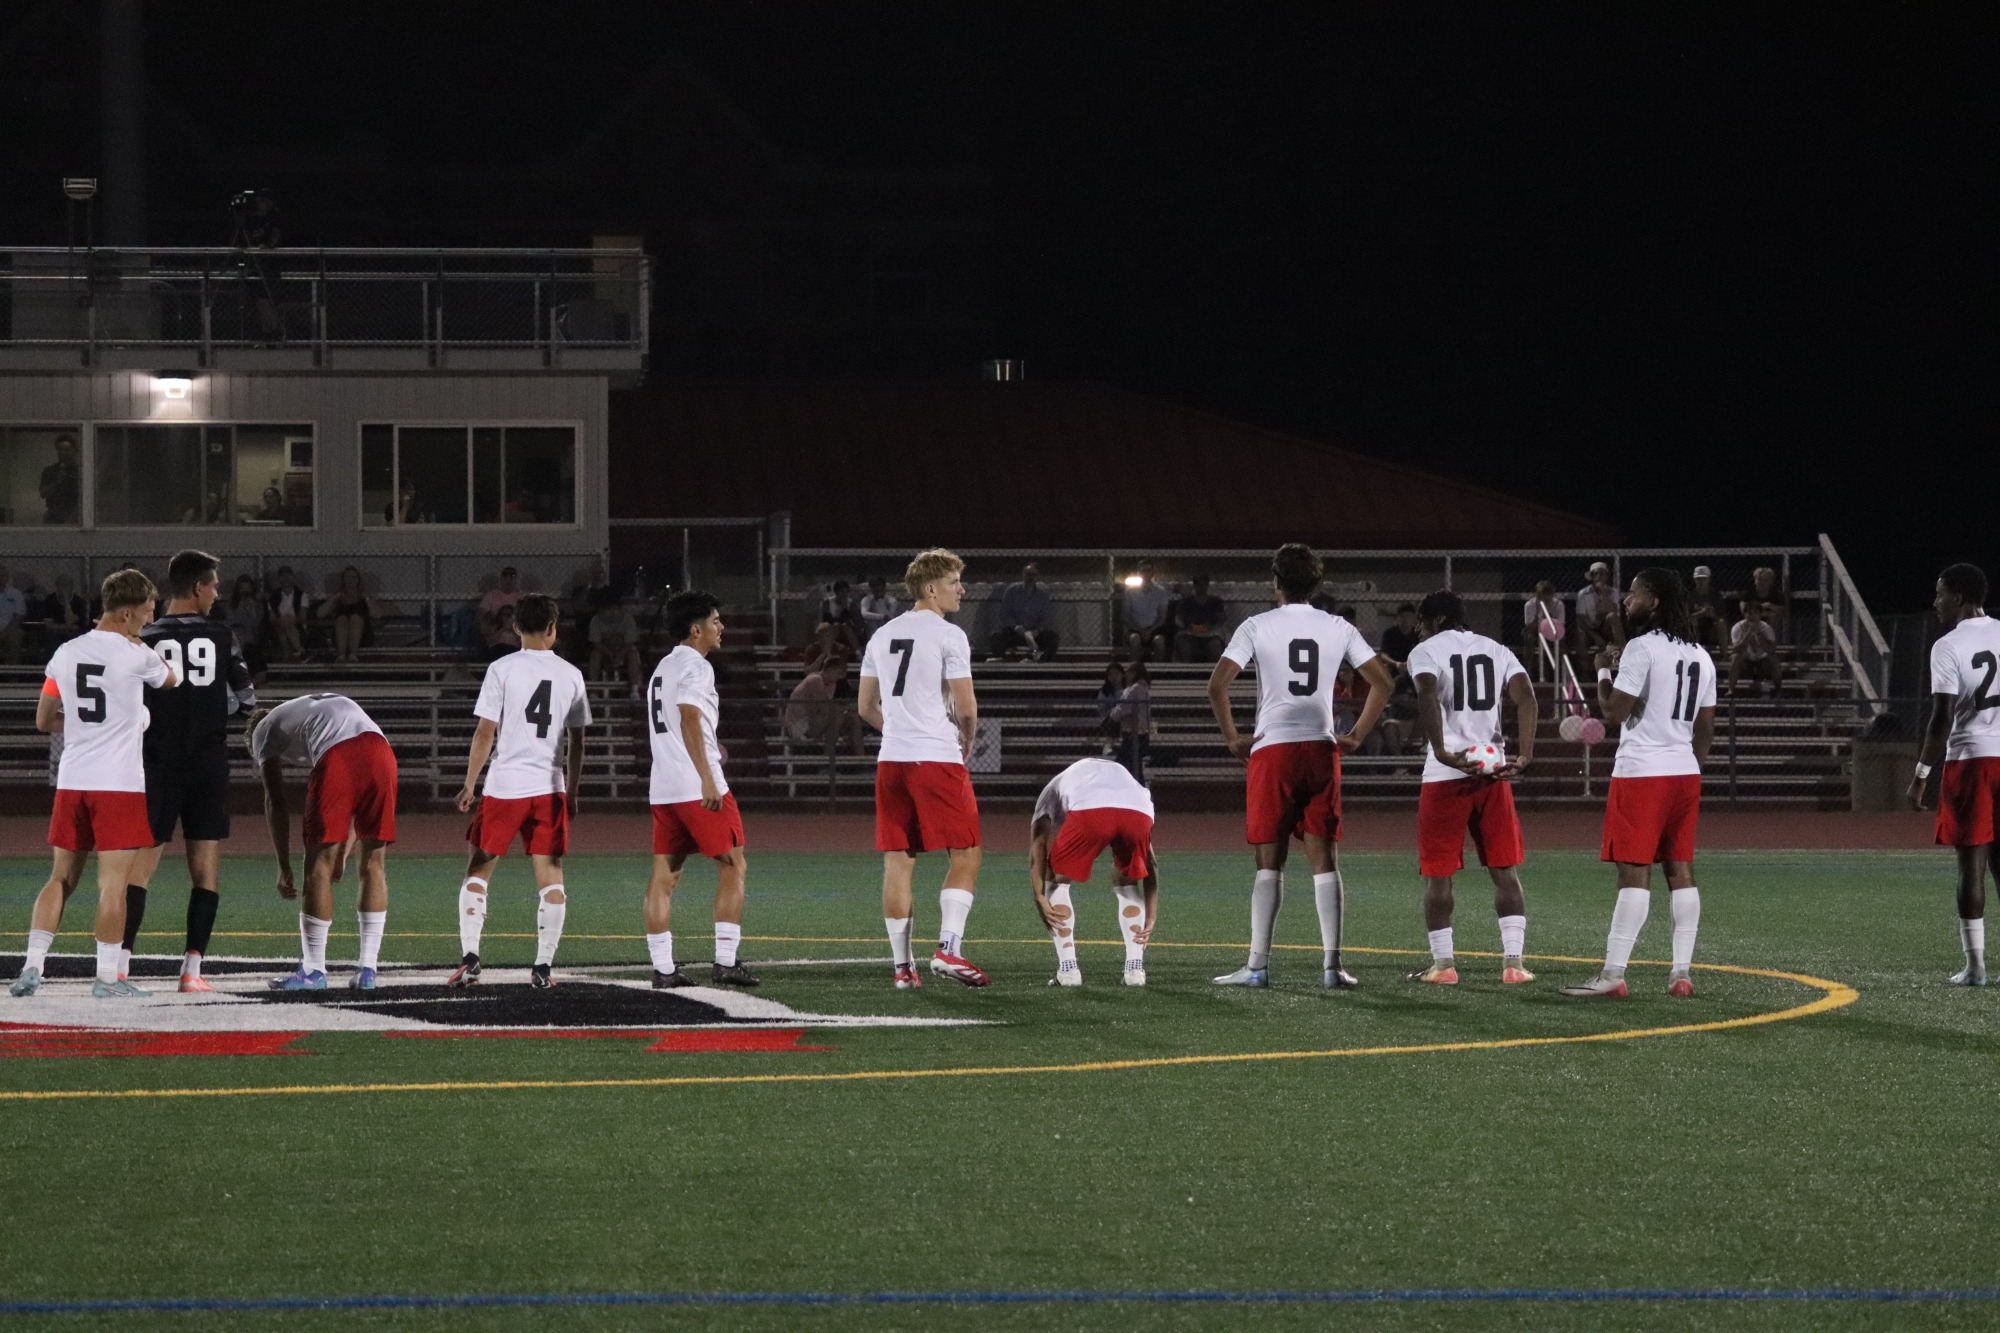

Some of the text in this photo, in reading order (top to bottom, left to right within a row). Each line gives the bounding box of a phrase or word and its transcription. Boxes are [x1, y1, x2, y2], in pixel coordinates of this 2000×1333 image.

[76, 663, 106, 723] 5
[889, 638, 915, 697] 7
[1288, 638, 1319, 697] 9
[1450, 654, 1495, 711] 10
[1671, 660, 1700, 721] 11
[1971, 650, 2000, 710] 2
[524, 679, 552, 739] 4
